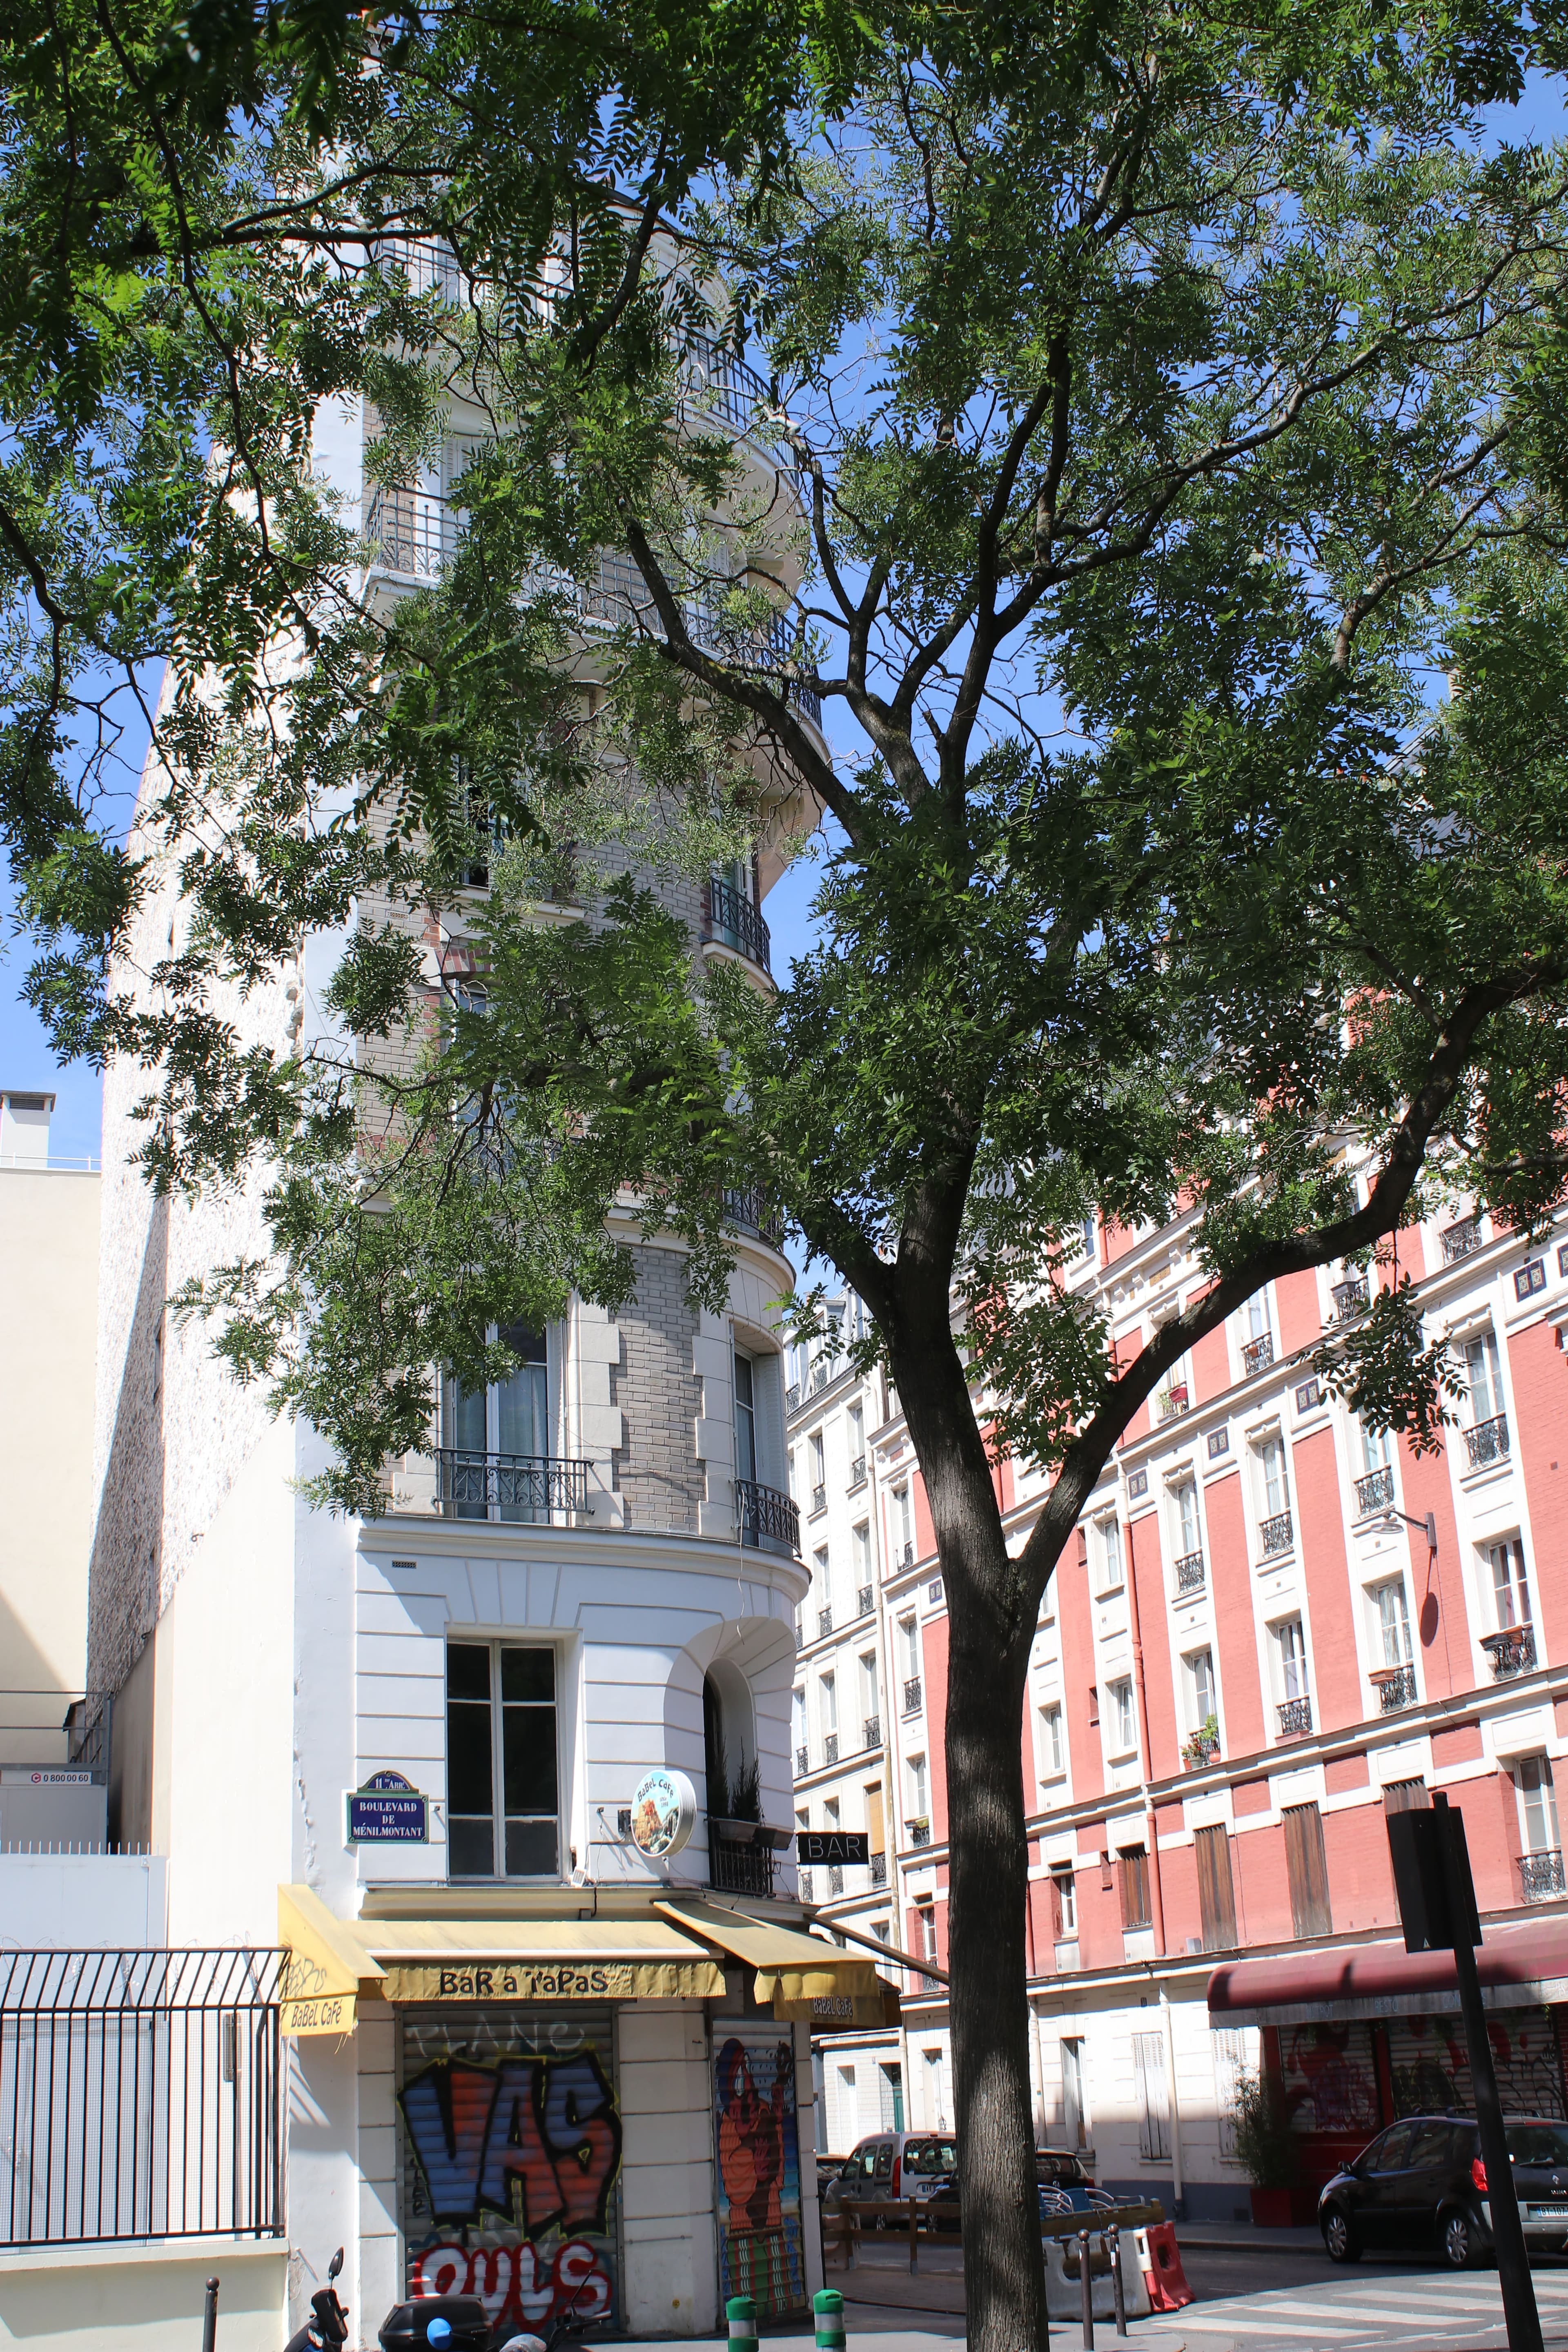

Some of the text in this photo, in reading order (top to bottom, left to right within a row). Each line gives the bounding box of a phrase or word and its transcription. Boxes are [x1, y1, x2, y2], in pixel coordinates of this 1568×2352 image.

[359, 1802, 417, 1812] BOULEVARD
[382, 1815, 395, 1824] DE
[353, 1822, 422, 1836] MÉNILMONTANT
[808, 1836, 861, 1858] BAR
